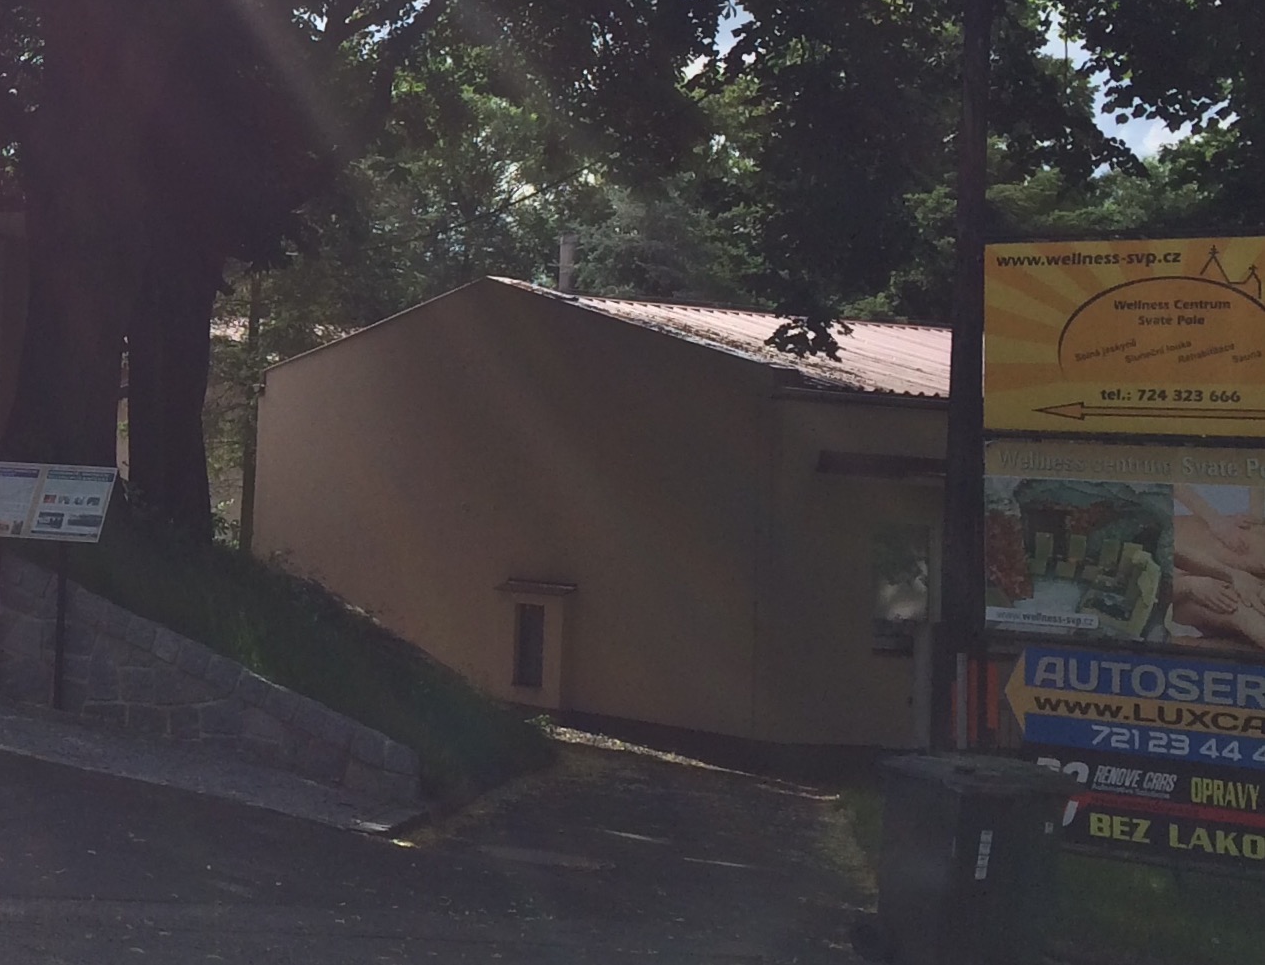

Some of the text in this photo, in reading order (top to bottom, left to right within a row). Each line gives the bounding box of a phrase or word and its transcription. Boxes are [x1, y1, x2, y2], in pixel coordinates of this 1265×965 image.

[996, 251, 1182, 267] www.wellness-svp.cz
[1113, 299, 1231, 311] Wellness Centrum
[1100, 388, 1241, 404] tel.: 724 323 666
[1034, 655, 1265, 709] AUTOSER
[1091, 724, 1140, 750] 721
[1147, 730, 1190, 756] 23
[1199, 737, 1243, 762] 44
[1093, 764, 1143, 788] RENOVE
[1143, 771, 1178, 793] CARS
[1190, 776, 1261, 811] OPRAVY
[1089, 811, 1265, 860] BEZ LAKO
